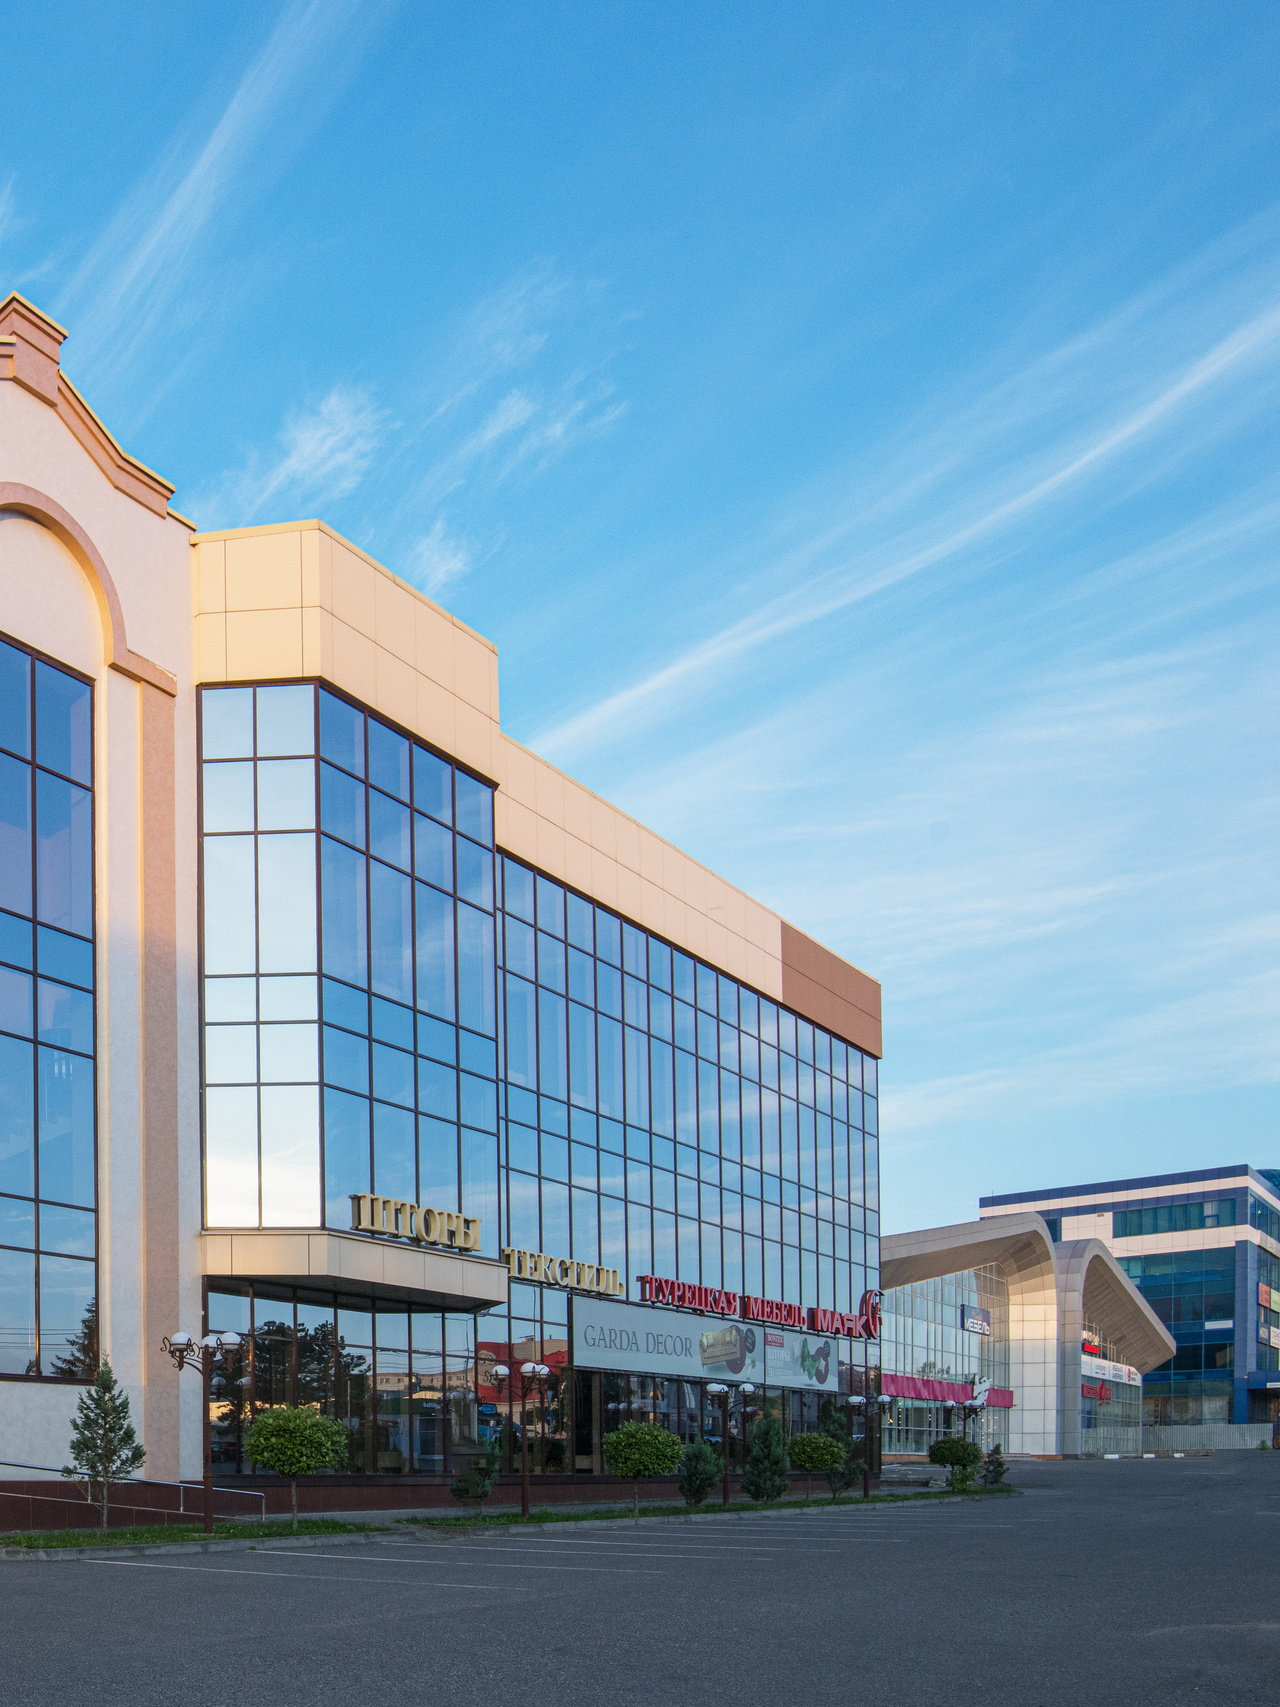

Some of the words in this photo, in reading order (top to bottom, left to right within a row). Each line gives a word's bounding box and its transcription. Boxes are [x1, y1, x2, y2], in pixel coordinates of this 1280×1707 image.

[355, 1193, 483, 1251] ШТОРЫ
[505, 1247, 624, 1296] ТЕКСТИЛЬ
[643, 1275, 739, 1315] ТУРЕЦКАЯ
[746, 1295, 807, 1327] МЕБЕЛЬ
[815, 1308, 867, 1338] МАЯК
[584, 1324, 640, 1353] GARDA
[645, 1331, 694, 1358] DECOR
